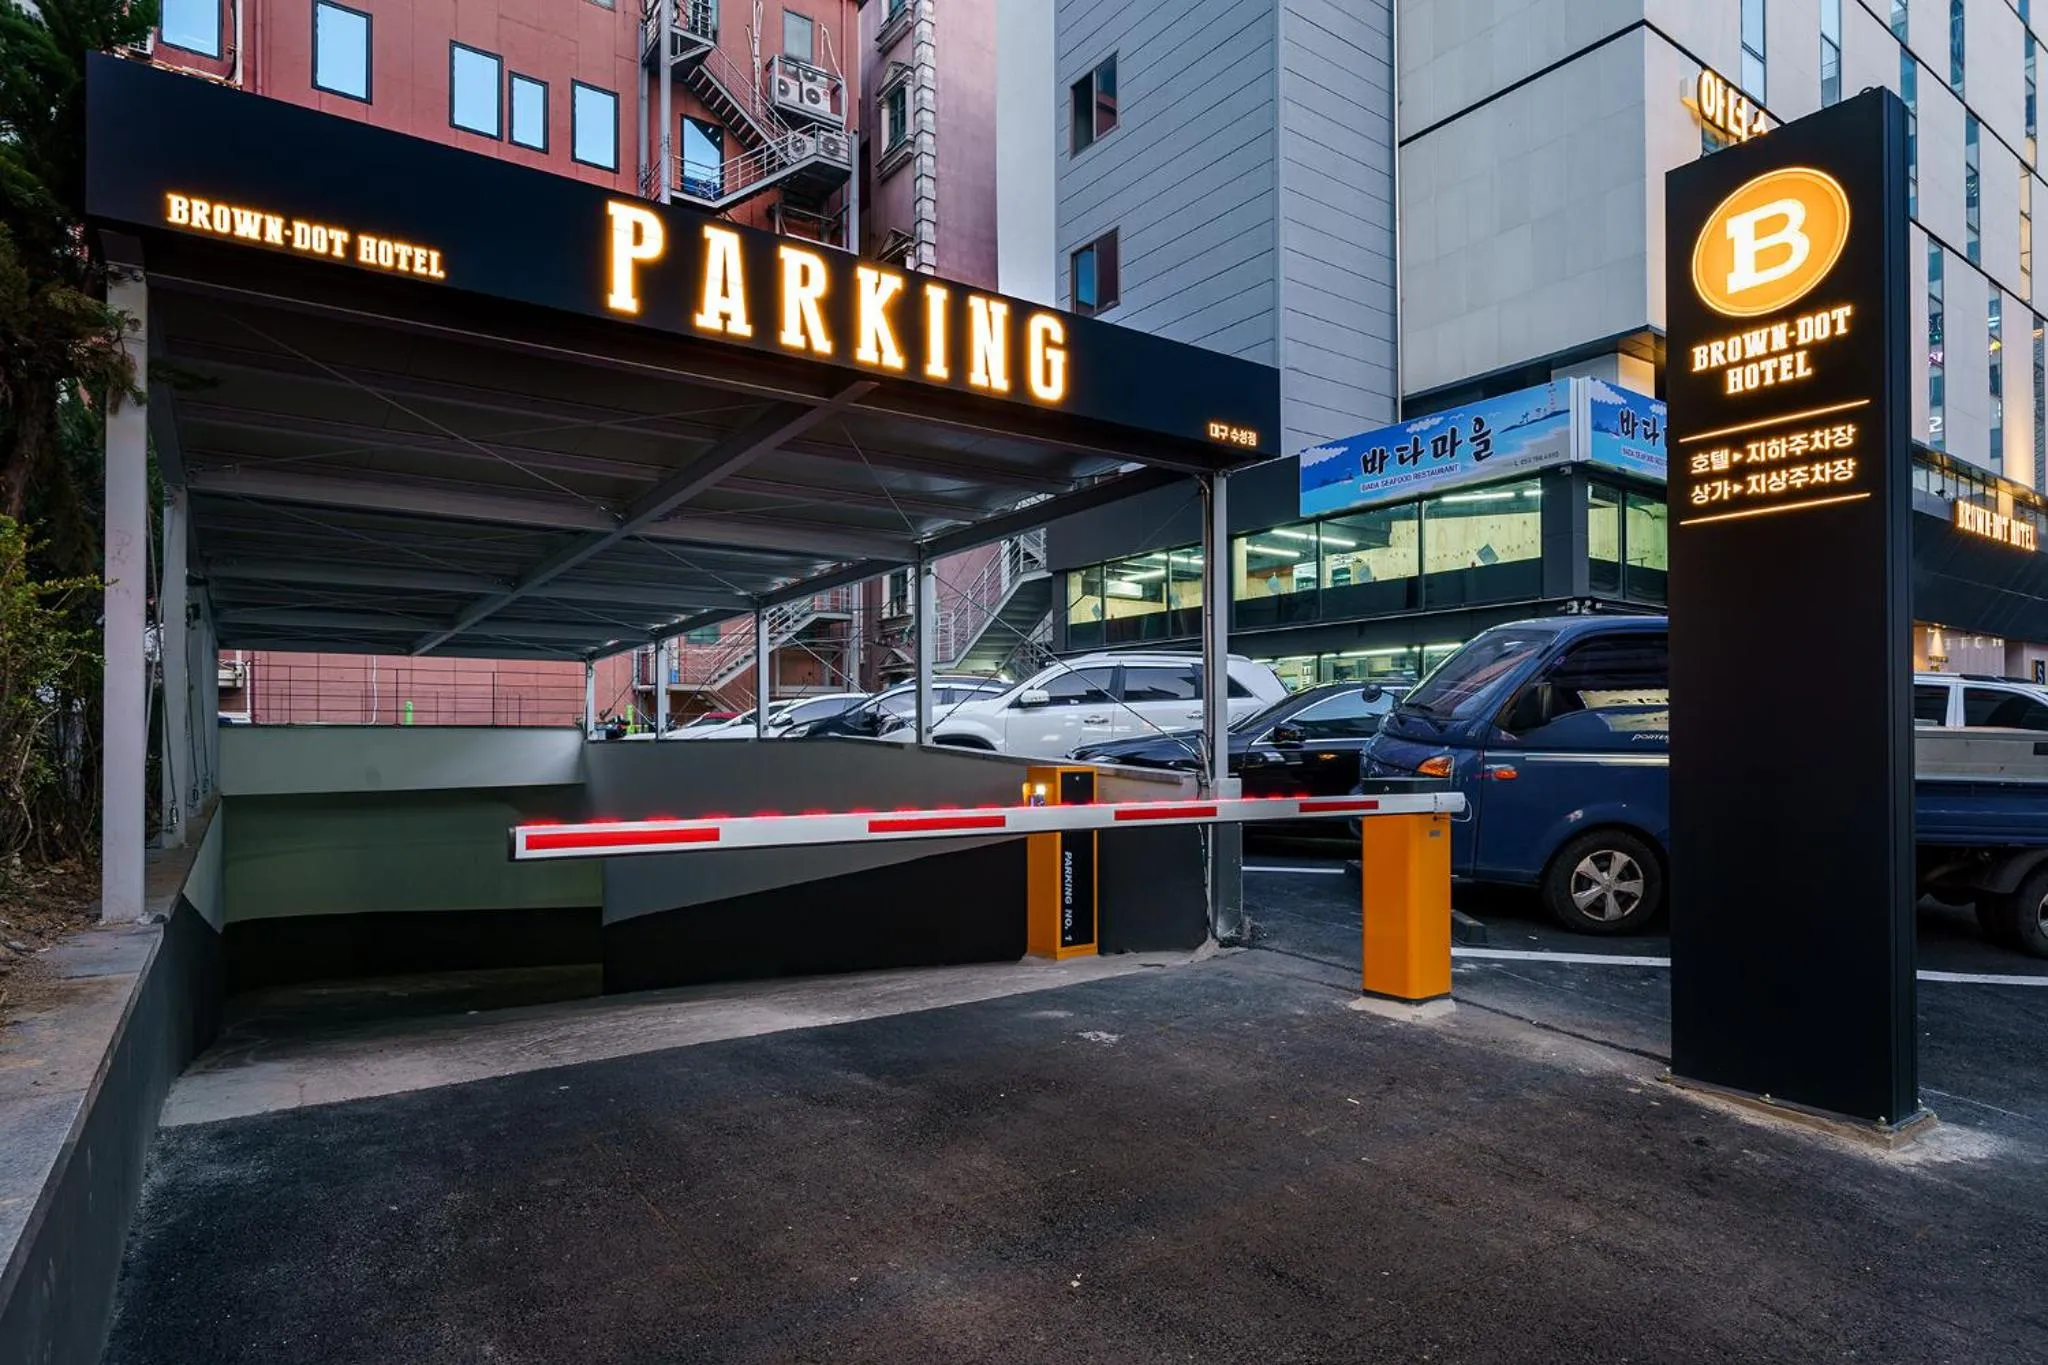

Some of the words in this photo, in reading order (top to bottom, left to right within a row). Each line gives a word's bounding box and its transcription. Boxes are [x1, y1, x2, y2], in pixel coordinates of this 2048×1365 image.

[356, 232, 446, 279] HOTEL
[1726, 199, 1811, 293] B
[605, 199, 1070, 404] PARKING
[1725, 349, 1814, 395] HOTEL
[1208, 422, 1229, 440] 대구
[1230, 427, 1257, 447] 수성점
[1360, 415, 1495, 475] 바다마을
[1620, 407, 1667, 449] 바다
[1690, 449, 1730, 475] 호텔
[1746, 424, 1857, 464] 지하주차장
[1413, 464, 1459, 480] RESTAURANT
[1690, 479, 1731, 505] 상가
[1746, 458, 1857, 495] 지상주차장
[2010, 519, 2036, 551] HOTEL
[1064, 851, 1073, 904] PARKING
[1064, 909, 1073, 929] NO.
